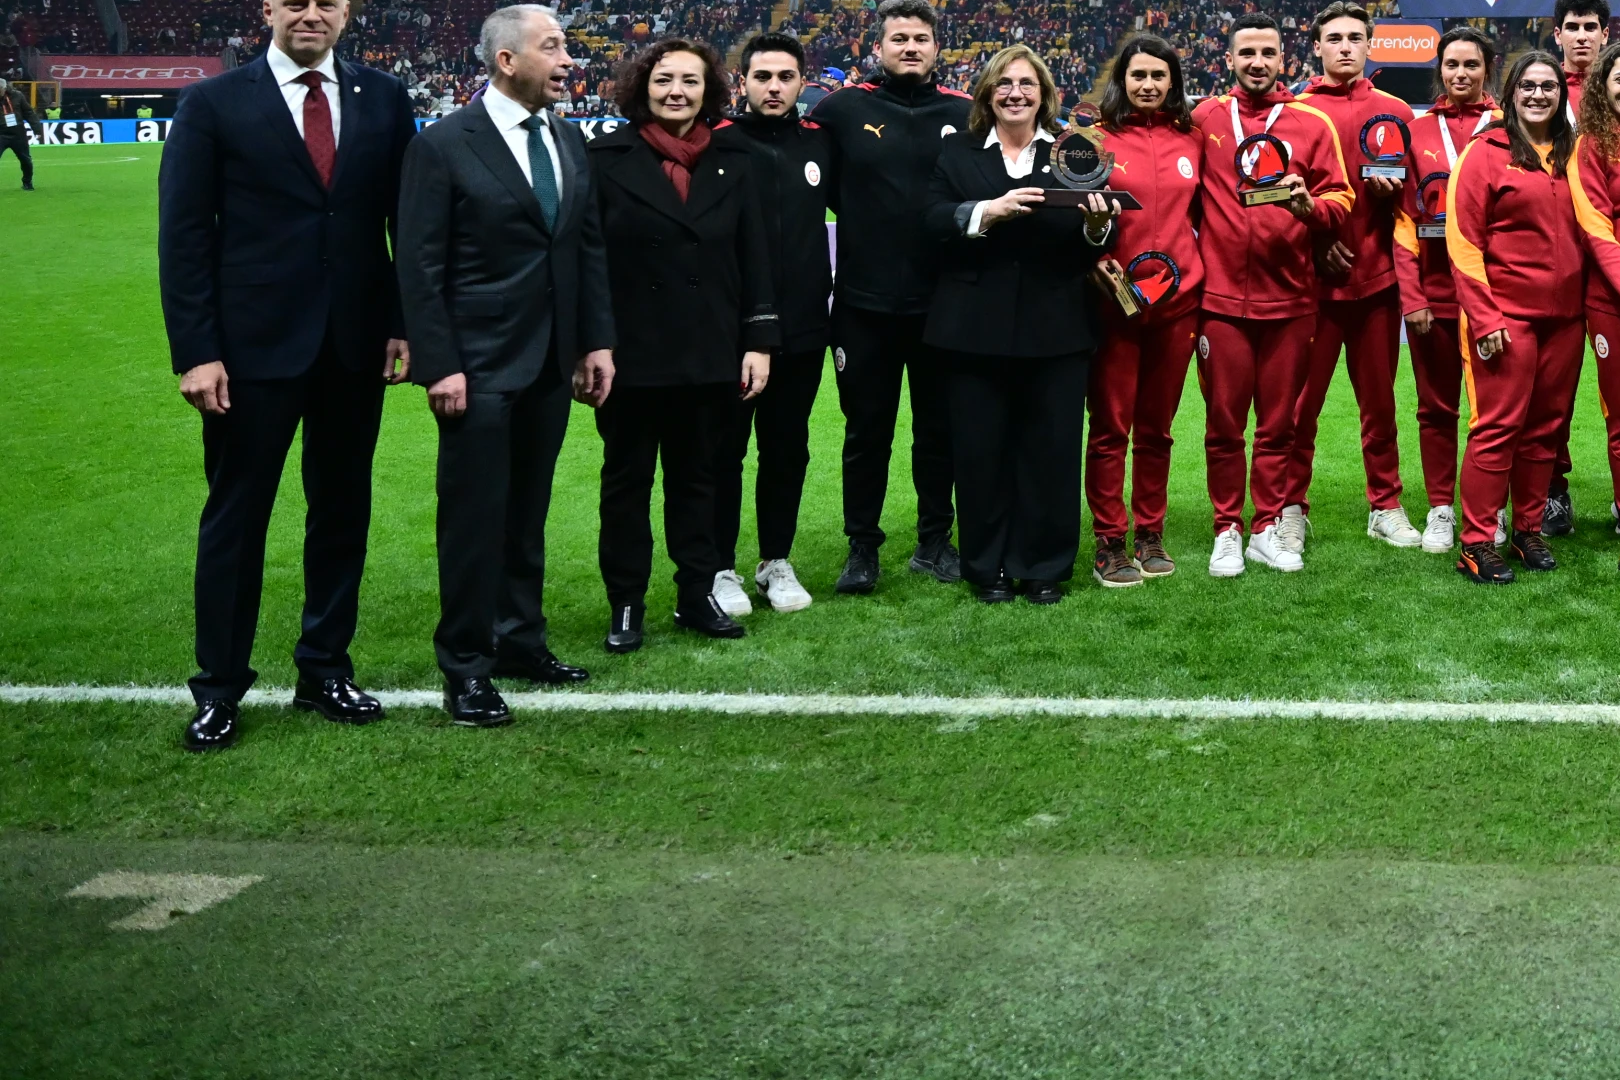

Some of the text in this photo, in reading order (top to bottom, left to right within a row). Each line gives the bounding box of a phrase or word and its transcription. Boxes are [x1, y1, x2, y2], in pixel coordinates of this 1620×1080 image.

[1371, 36, 1434, 52] trendyol
[50, 64, 208, 80] ÜLKER
[1070, 149, 1094, 159] 1905
